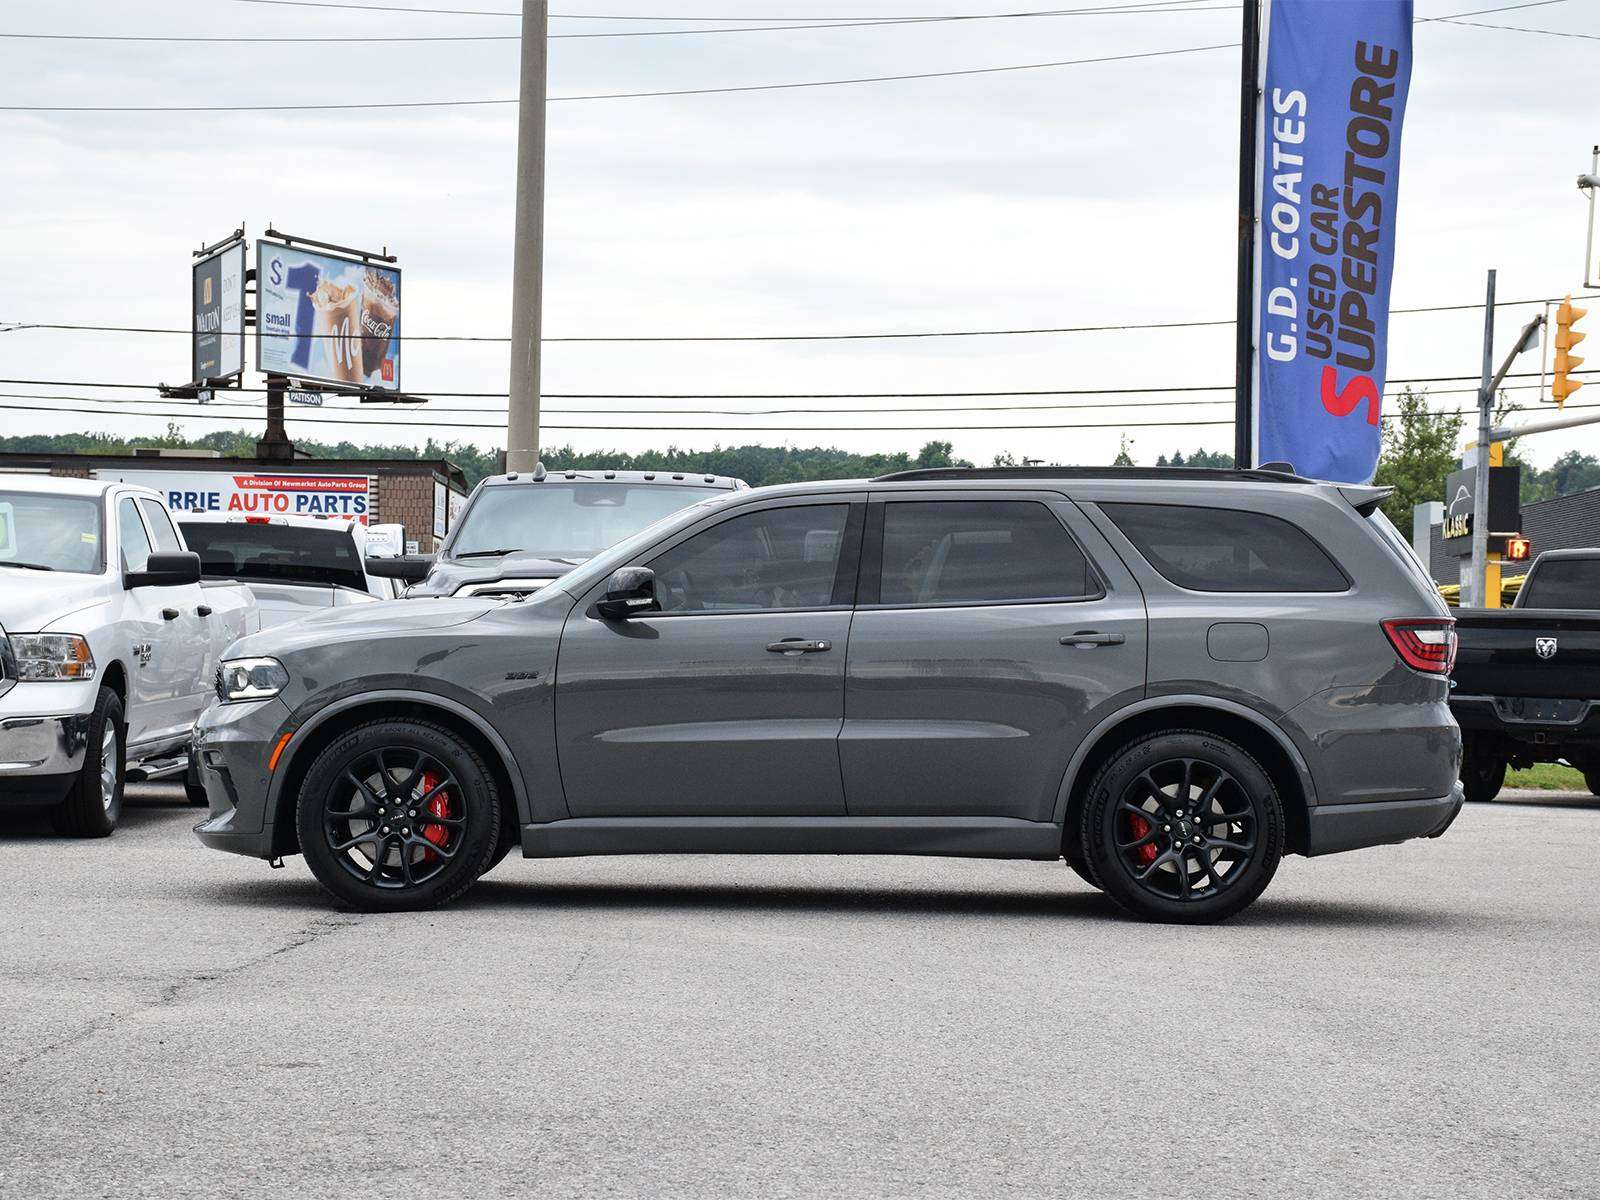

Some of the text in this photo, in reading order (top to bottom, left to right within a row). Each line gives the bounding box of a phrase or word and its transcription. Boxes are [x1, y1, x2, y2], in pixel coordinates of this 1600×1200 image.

[1266, 87, 1307, 363] G.D. COATES
[1320, 40, 1399, 426] SUPERSTORE
[1305, 182, 1339, 359] USED CAR
[265, 312, 290, 328] small
[291, 392, 321, 404] PATTISON
[249, 479, 272, 487] Division
[282, 480, 317, 488] Newmarket
[348, 482, 367, 490] Group
[161, 490, 367, 514] RRIE AUTO PARTS
